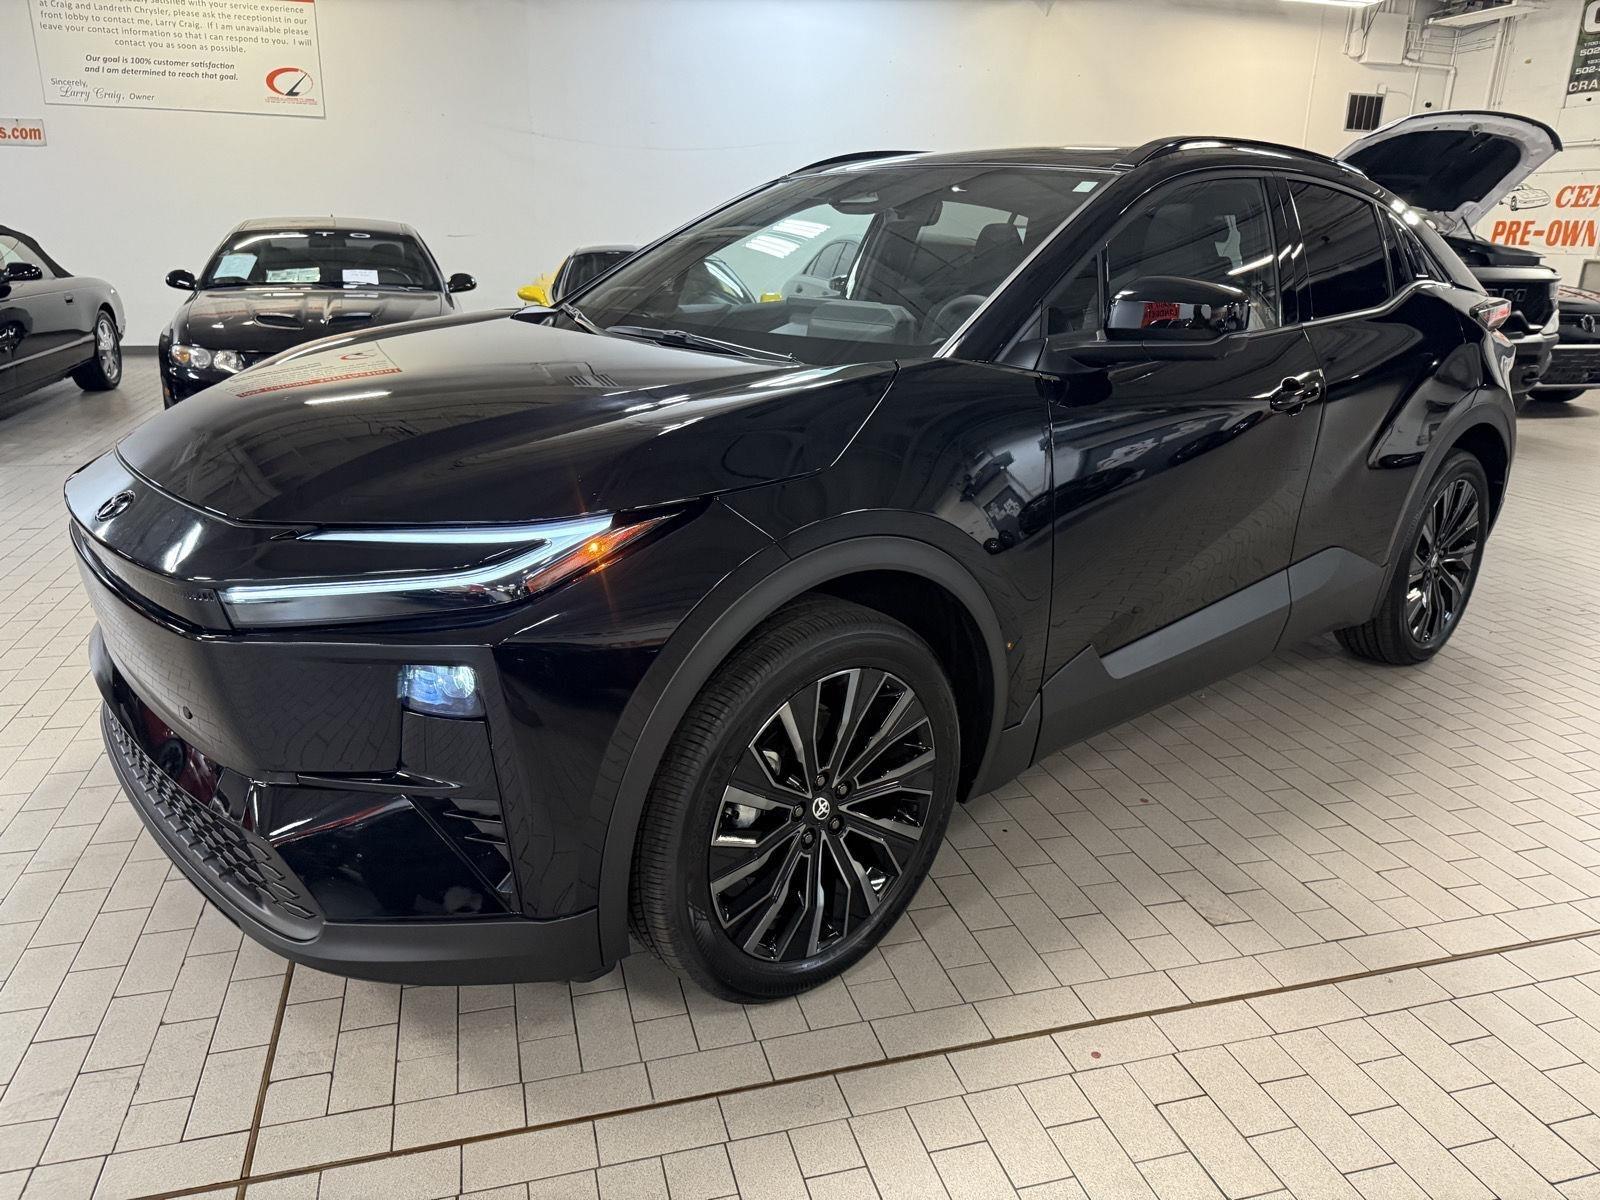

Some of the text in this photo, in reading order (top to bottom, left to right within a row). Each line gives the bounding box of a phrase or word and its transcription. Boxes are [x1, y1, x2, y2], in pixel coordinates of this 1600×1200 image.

[50, 0, 73, 10] Craig
[75, 2, 91, 10] and
[94, 3, 131, 13] Landreth
[134, 5, 170, 16] Chrysler,
[173, 9, 200, 17] please
[217, 12, 231, 20] the
[233, 14, 282, 23] receptionist
[284, 16, 292, 24] in
[229, 2, 258, 10] service
[260, 5, 304, 14] experience
[40, 10, 63, 19] front
[64, 11, 89, 22] lobby
[91, 14, 101, 22] to
[103, 16, 135, 24] contact
[137, 18, 153, 26] me,
[155, 18, 177, 28] Larry
[178, 20, 202, 30] Craig.
[207, 21, 213, 29] If
[220, 23, 233, 31] am
[235, 25, 281, 33] unavailable
[283, 27, 309, 36] please
[39, 22, 63, 30] leave
[87, 26, 119, 35] contact
[121, 27, 171, 37] information
[225, 35, 259, 43] respond
[114, 39, 146, 47] contact
[177, 42, 197, 50] soon
[85, 54, 235, 70] Our goal is 100% customer satisfaction
[84, 65, 100, 73] and
[121, 67, 166, 76] determined
[201, 72, 217, 80] that
[219, 73, 238, 81] goal.
[50, 77, 88, 88] Sincerely,
[59, 85, 91, 102] Larry
[129, 92, 155, 101] Owner
[1490, 219, 1598, 247] PRE-OWN
